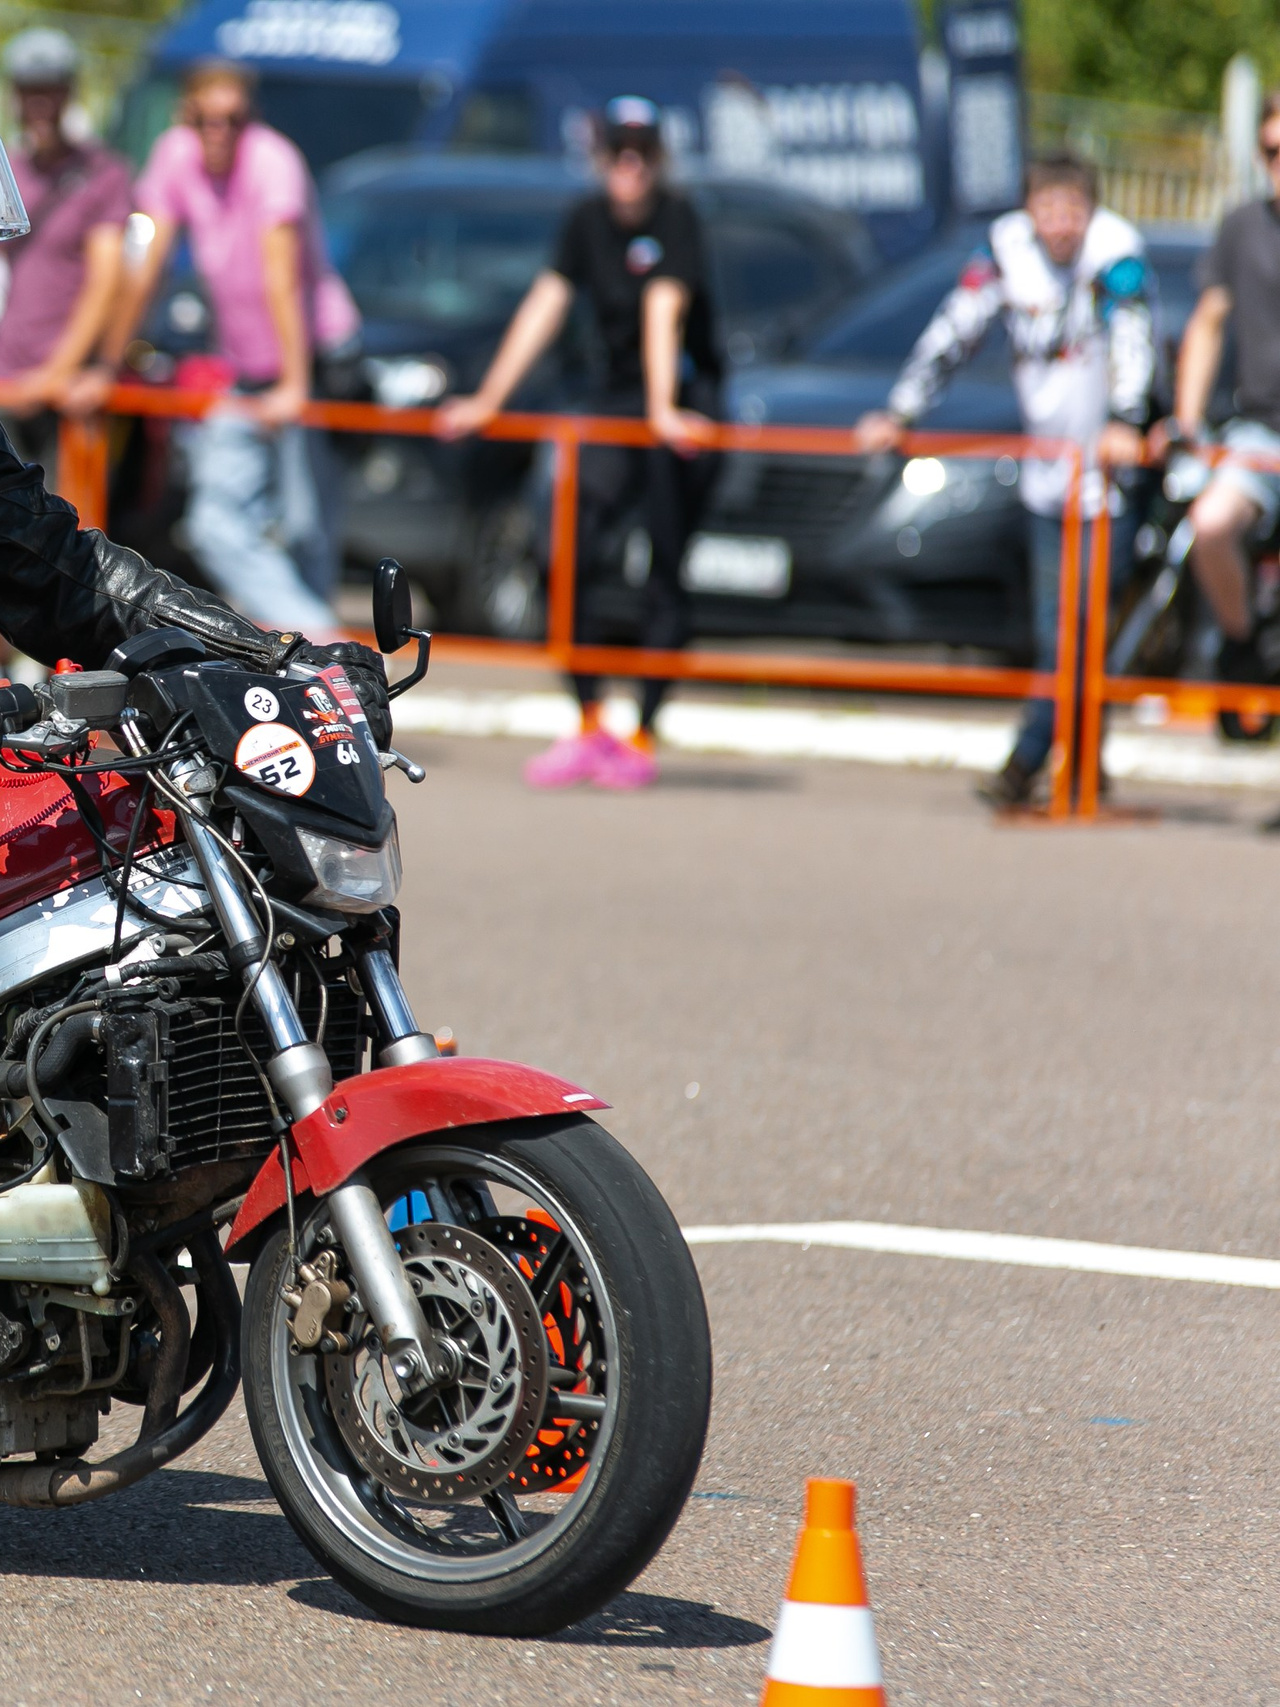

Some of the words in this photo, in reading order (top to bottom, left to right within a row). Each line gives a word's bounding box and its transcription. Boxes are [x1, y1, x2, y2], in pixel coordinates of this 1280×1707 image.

[252, 694, 272, 714] 23
[337, 743, 361, 765] 66
[259, 756, 301, 786] 52
